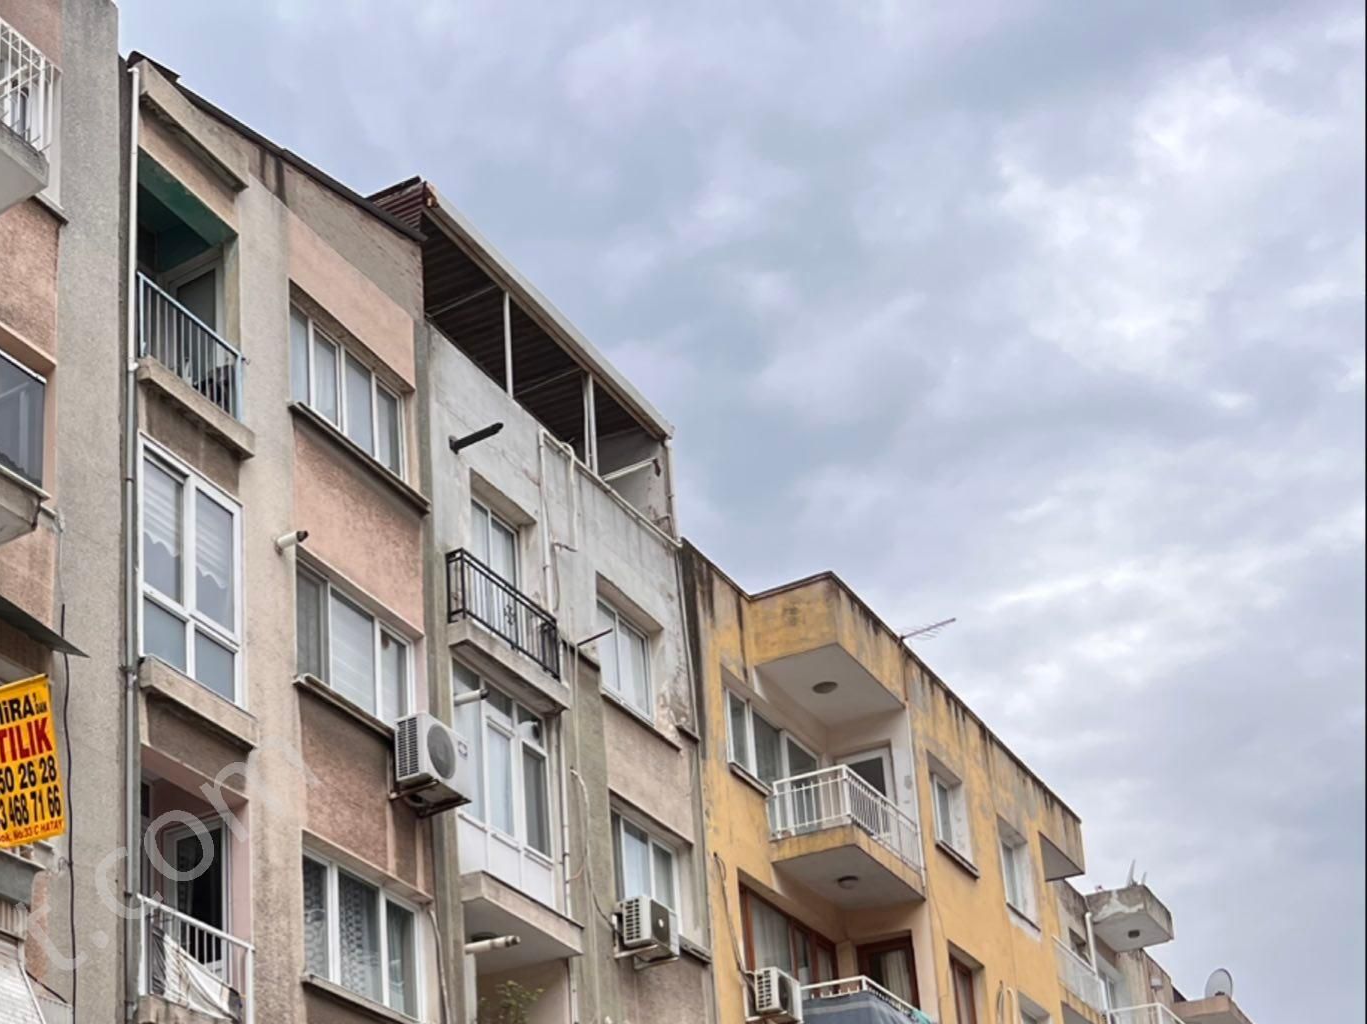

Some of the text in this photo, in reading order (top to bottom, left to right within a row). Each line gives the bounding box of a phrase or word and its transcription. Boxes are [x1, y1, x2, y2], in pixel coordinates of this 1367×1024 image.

[18, 761, 37, 790] 26
[39, 755, 57, 784] 28
[8, 795, 29, 824] 468
[47, 785, 61, 818] 66
